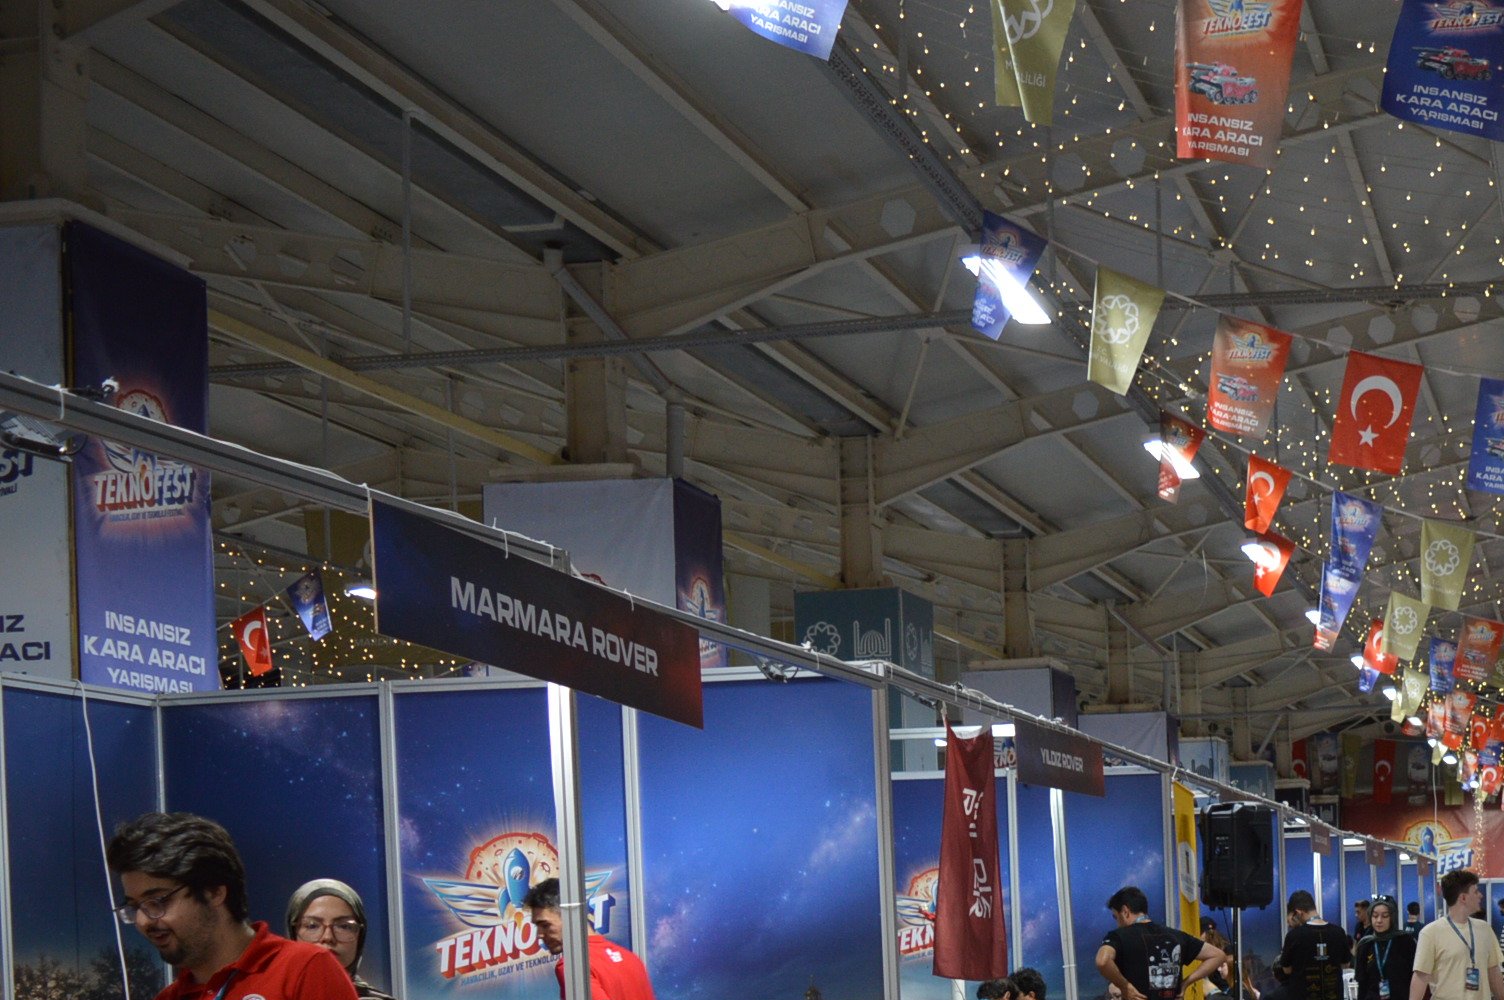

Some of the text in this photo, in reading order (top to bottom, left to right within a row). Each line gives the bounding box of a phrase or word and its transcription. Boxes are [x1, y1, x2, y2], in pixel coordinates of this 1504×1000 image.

[782, 14, 821, 34] ARACI
[1201, 4, 1273, 34] TEKNOFEST
[1430, 12, 1504, 31] TEKNOFEST
[1396, 94, 1498, 121] KARA ARACI
[1413, 85, 1488, 105] INSANSIZ
[1214, 131, 1263, 146] ARACI
[93, 466, 196, 512] TEKNOFEST
[1476, 472, 1502, 481] KARA
[105, 610, 191, 647] INSANSIZ
[451, 576, 659, 678] MARMARA ROVER
[84, 634, 206, 676] KARA ARACI
[107, 667, 193, 694] YARIŞMASI
[436, 893, 616, 979] TEKNOT
[498, 964, 514, 977] UZAY
[515, 962, 524, 971] VE
